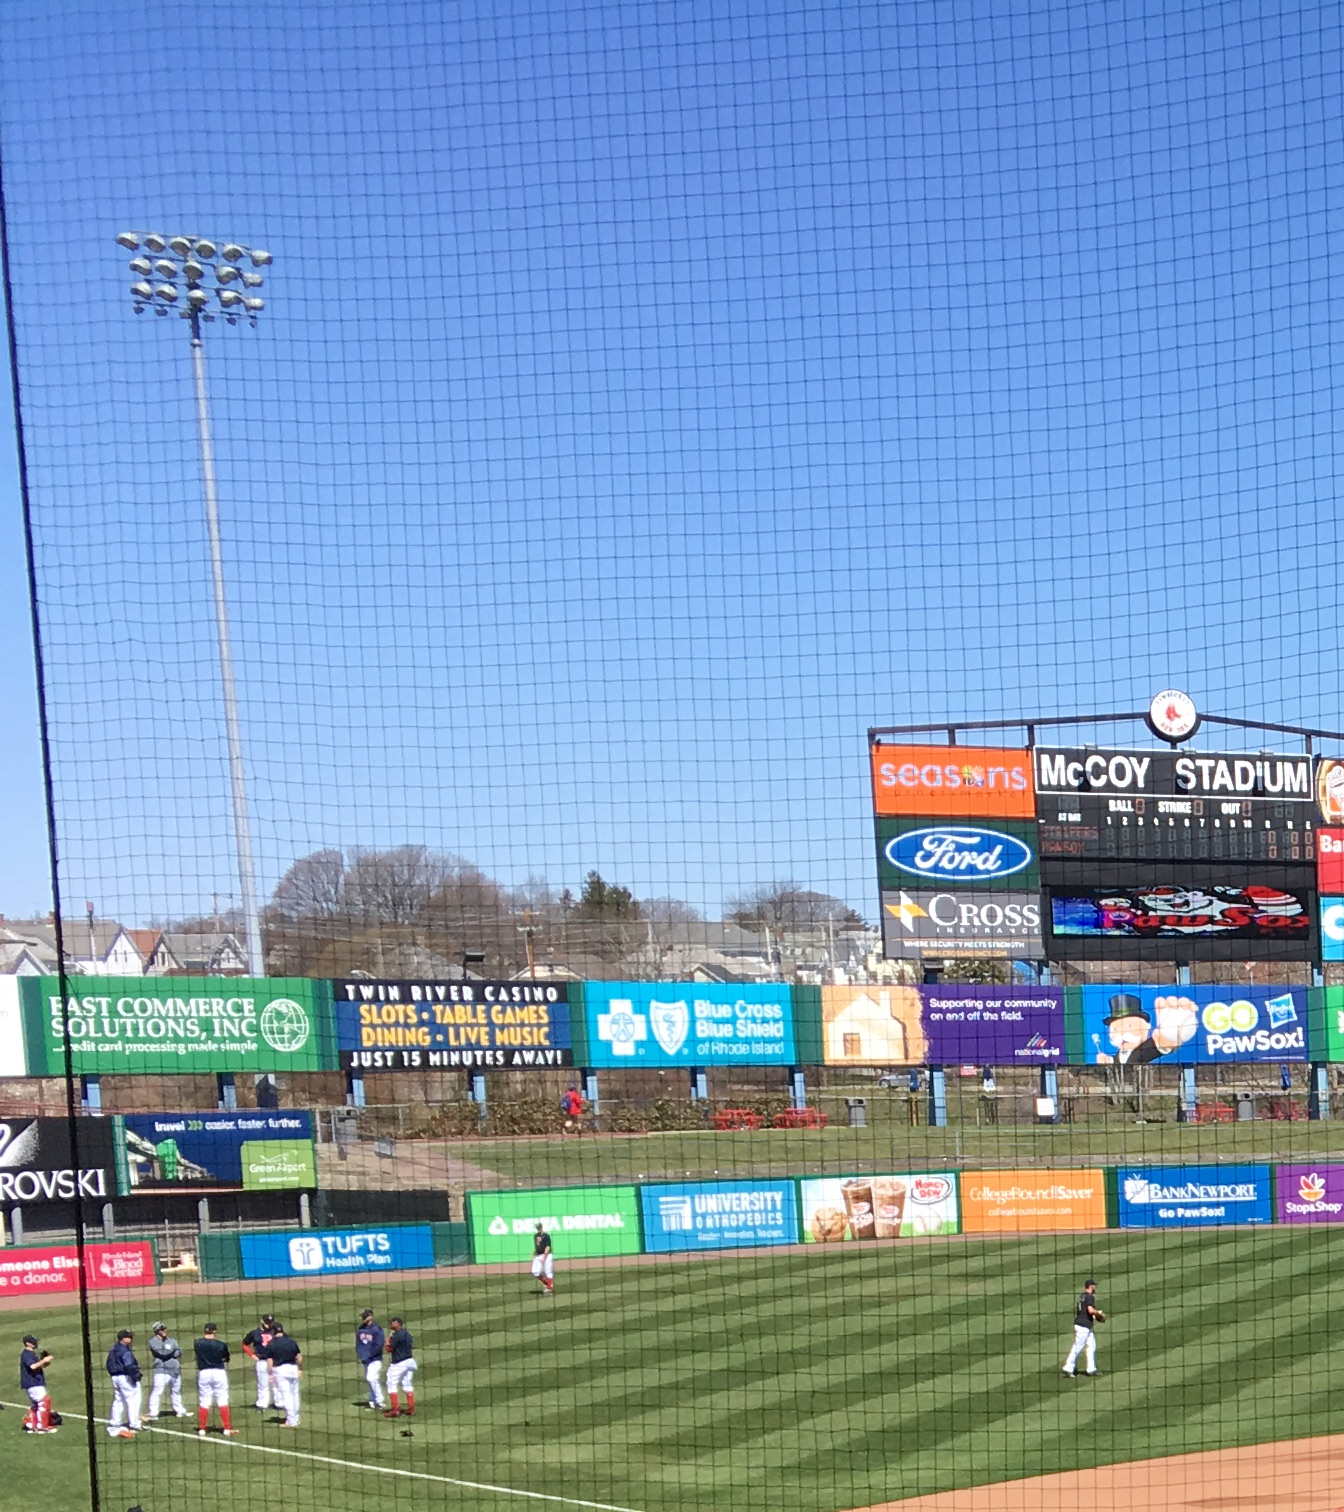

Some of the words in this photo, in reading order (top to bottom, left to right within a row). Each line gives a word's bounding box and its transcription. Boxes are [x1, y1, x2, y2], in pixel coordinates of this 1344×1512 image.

[1041, 754, 1150, 788] McCOY
[1175, 758, 1308, 793] STADIUM
[1158, 801, 1192, 814] STRIKE
[1222, 803, 1241, 814] OUT
[914, 833, 1002, 872] Ford
[928, 894, 1040, 926] CROSS
[345, 985, 399, 1001] TWIN
[412, 986, 473, 1001] RIVER
[484, 986, 558, 1001] CASINO
[49, 997, 111, 1017] EAST
[117, 998, 255, 1017] COMMERCE
[694, 1000, 731, 1018] Blue
[735, 1000, 782, 1018] Cross
[930, 998, 983, 1011] Supporting
[986, 1000, 1001, 1009] our
[1004, 998, 1056, 1011] community
[359, 1005, 417, 1024] SLOTS
[432, 1005, 488, 1024] TABLE
[491, 1006, 548, 1024] GAMES
[946, 1011, 964, 1020] and
[967, 1011, 981, 1020] off
[983, 1011, 998, 1020] the
[1202, 1000, 1258, 1034] GO
[213, 1017, 257, 1037] INC
[696, 1020, 733, 1038] Blue
[736, 1020, 784, 1038] Shield
[361, 1027, 431, 1047] DINING
[448, 1027, 490, 1046] LIVE
[496, 1027, 549, 1046] MUSIC
[1207, 1027, 1304, 1055] PawSox!
[97, 1041, 122, 1052] card
[125, 1040, 185, 1055] processing
[187, 1041, 218, 1051] made
[220, 1041, 258, 1054] simple
[697, 1042, 710, 1055] of
[712, 1042, 749, 1055] Rhode
[752, 1041, 784, 1054] Island
[350, 1051, 393, 1067] JUST
[402, 1051, 420, 1066] 15
[429, 1050, 504, 1066] MINUTES
[512, 1050, 562, 1065] AWAY!
[155, 1121, 185, 1131] travel
[694, 1191, 783, 1213] UNIVERSITY
[696, 1212, 783, 1229] ORTHOPEDICS
[1159, 1208, 1175, 1218] Go
[562, 1214, 624, 1230] DENTAL
[323, 1234, 390, 1253] TUFTS
[326, 1254, 364, 1267] Health
[367, 1253, 391, 1267] Plan
[11, 1277, 20, 1285] a
[24, 1273, 66, 1286] donor.
